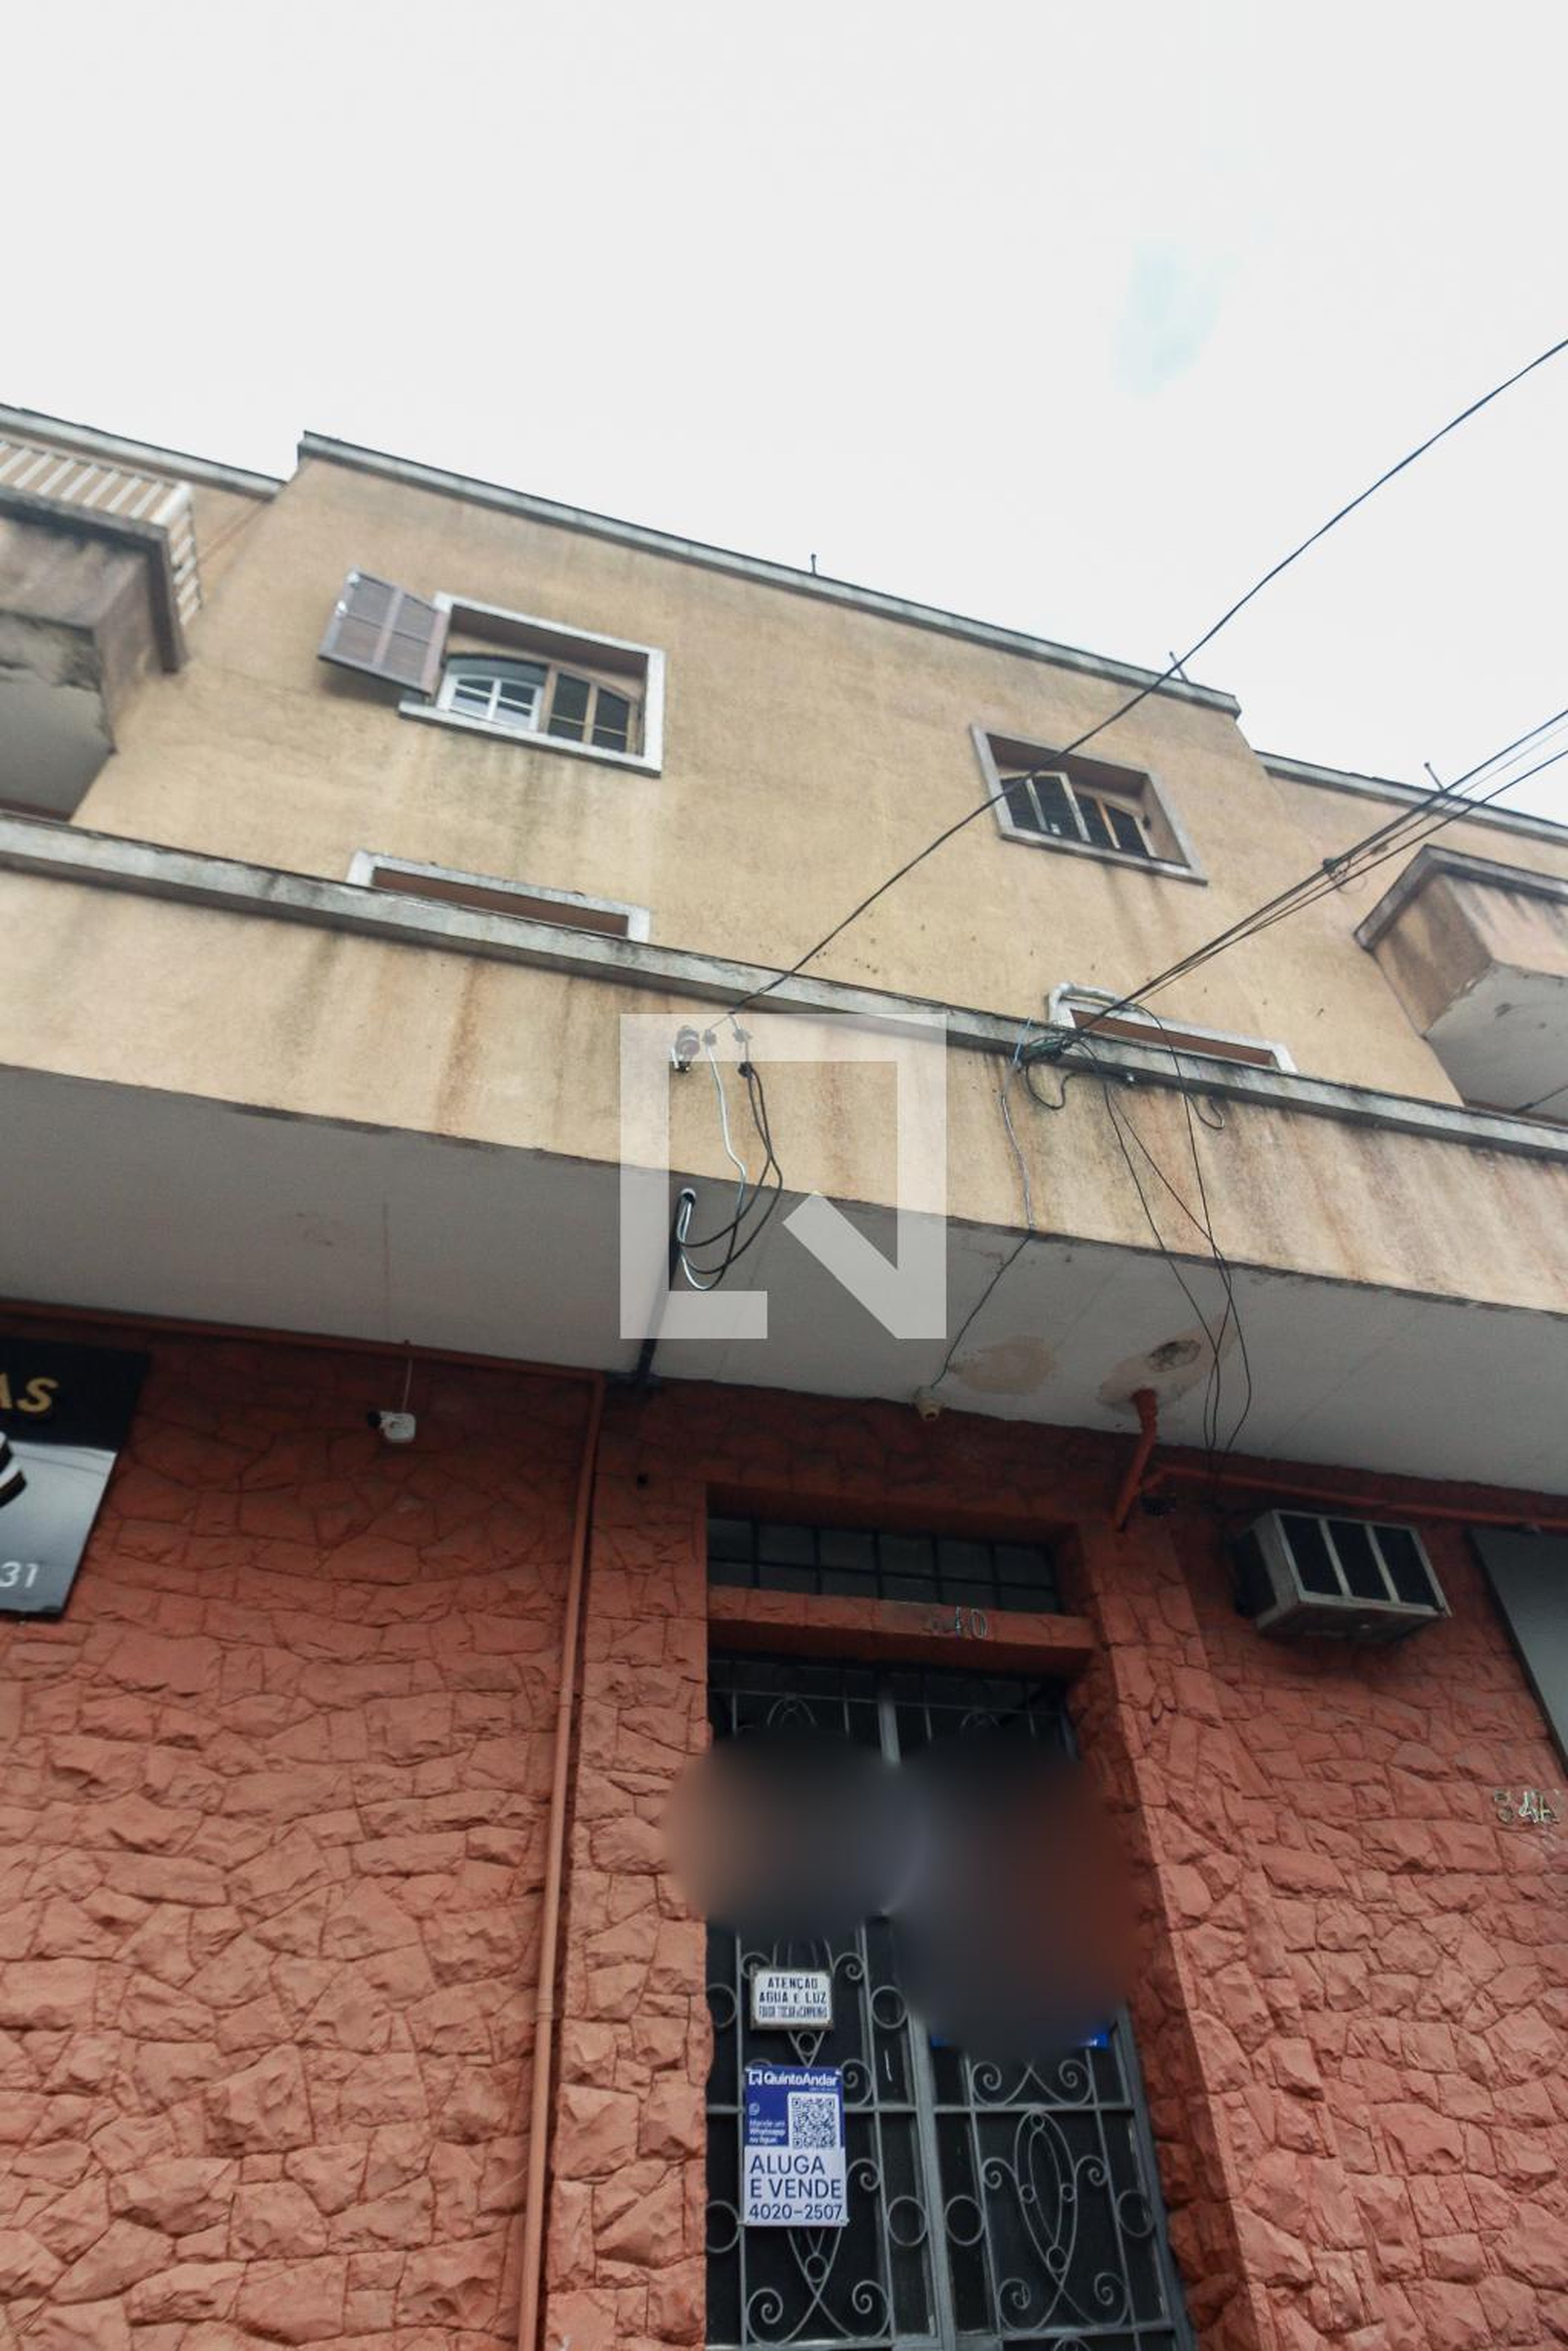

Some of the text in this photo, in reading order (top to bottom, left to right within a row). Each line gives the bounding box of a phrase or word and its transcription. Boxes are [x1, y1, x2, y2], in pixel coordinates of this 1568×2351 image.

[805, 1992, 827, 2004] LUZ
[764, 2071, 837, 2086] QuintoAndar
[749, 2155, 825, 2175] ALUGA
[751, 2179, 842, 2199] E VENDE
[749, 2204, 843, 2220] 4020-2507
